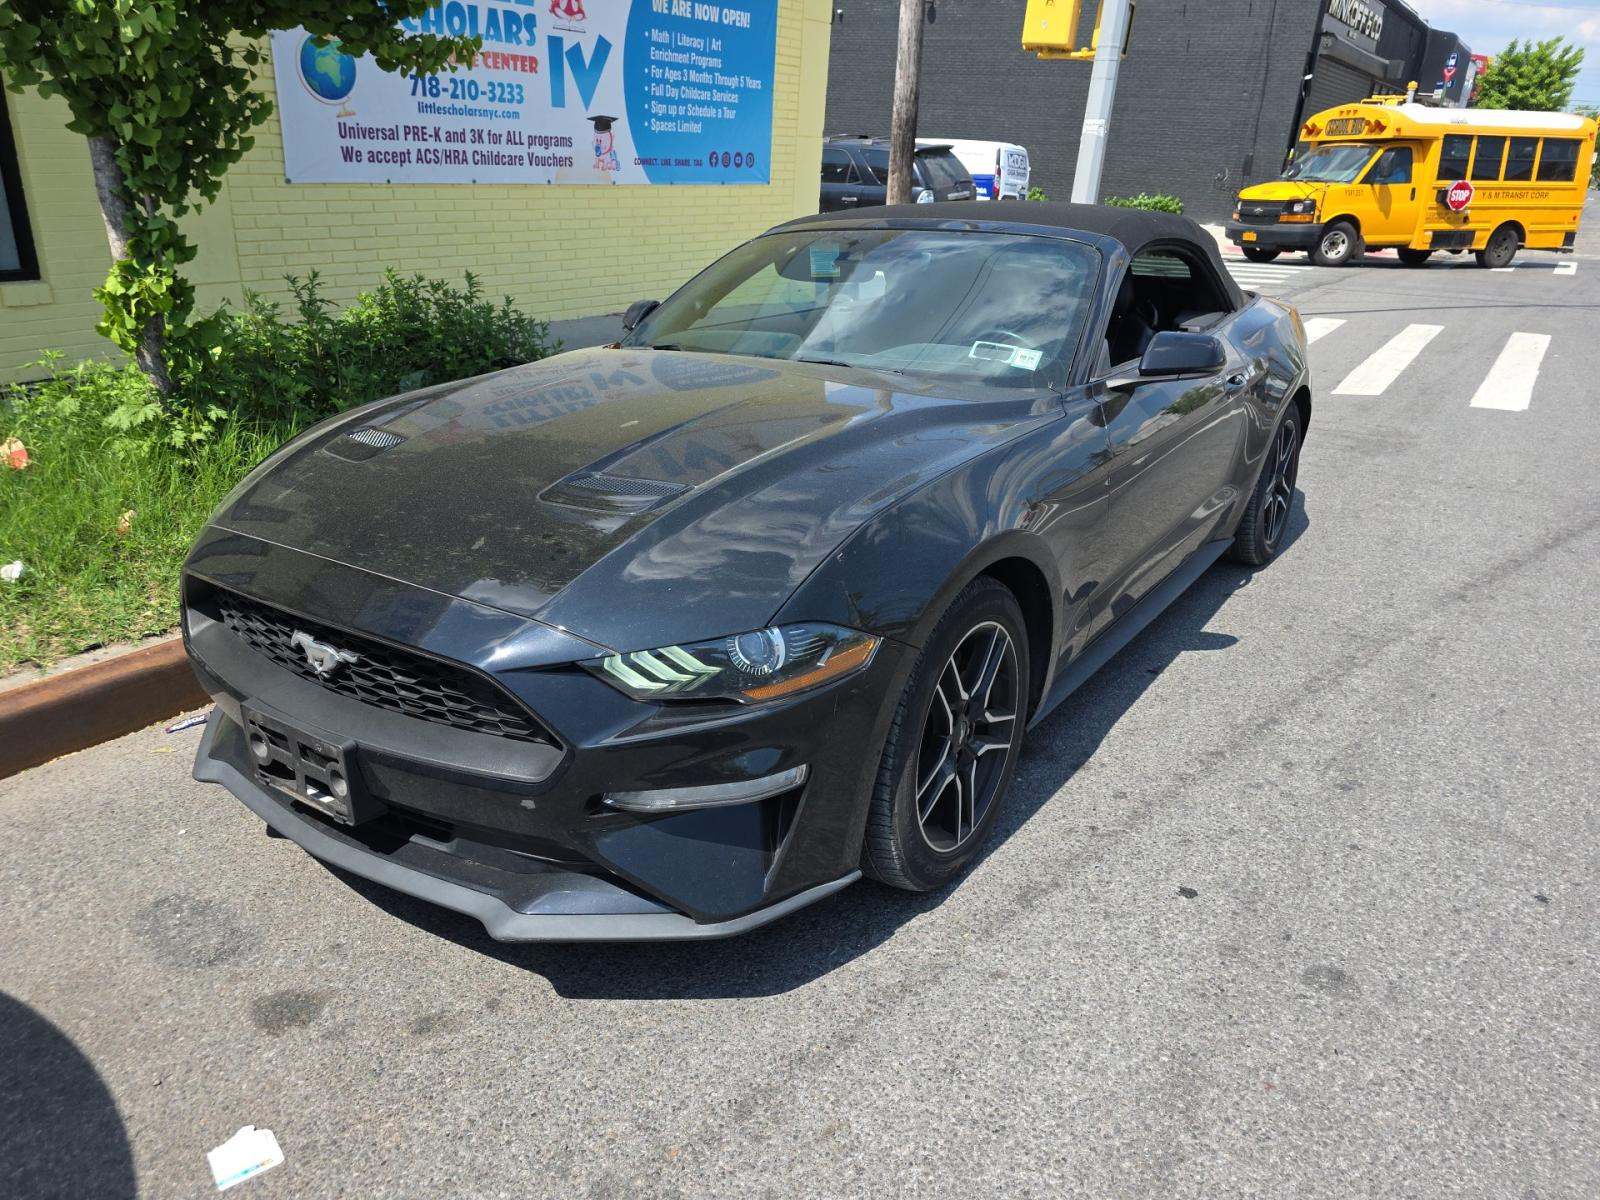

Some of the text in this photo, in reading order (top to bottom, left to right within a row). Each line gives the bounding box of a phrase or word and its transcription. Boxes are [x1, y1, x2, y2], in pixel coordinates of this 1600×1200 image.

[398, 0, 537, 47] CHOLARS
[652, 0, 751, 28] WE ARE NOW OPEN!
[651, 28, 722, 51] Math Literacy Art
[483, 51, 538, 74] CENTER
[650, 47, 722, 69] Enrichment Programs
[547, 34, 613, 112] IV
[651, 65, 762, 90] For Ages 3 Months Through 5 Years
[409, 74, 525, 104] 718-210-3233
[651, 83, 739, 103] Full Day Childcare Services
[417, 101, 520, 120] littlescholarsnyc.com
[651, 100, 736, 119] Sign up or Schedule a Tour
[338, 122, 573, 149] Universal PRE-K and 3K for ALL programs
[650, 118, 702, 133] Spaces Limited
[341, 145, 573, 168] We accept ACS/HRA Childcare Vouchers
[1450, 189, 1470, 202] STOP
[1502, 191, 1530, 200] TRANSIT
